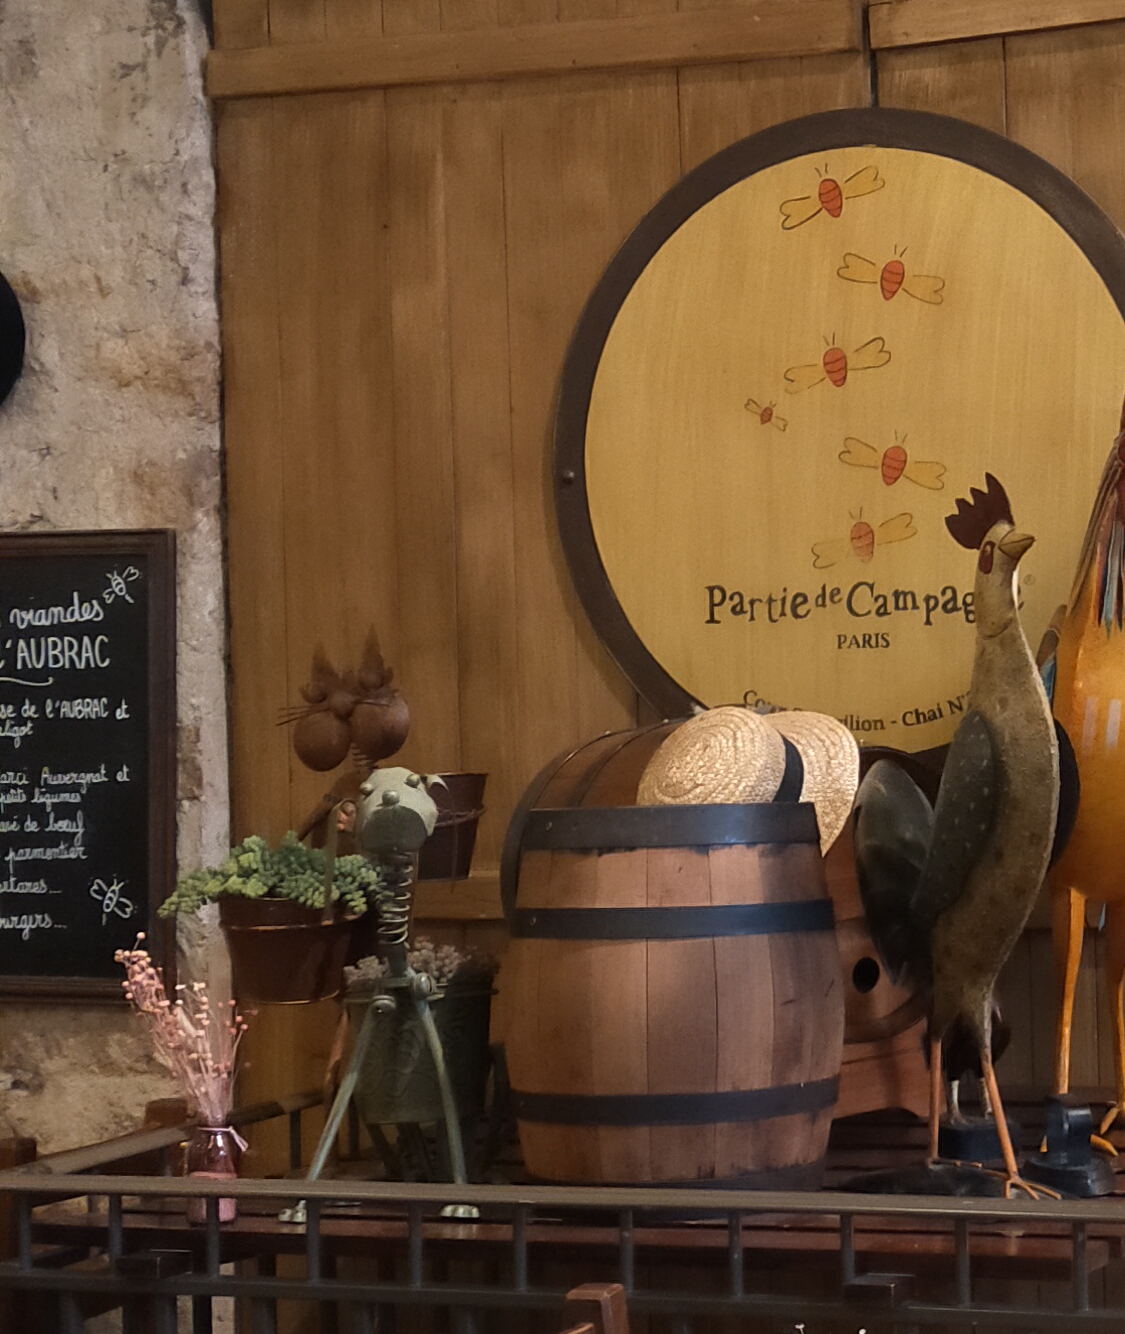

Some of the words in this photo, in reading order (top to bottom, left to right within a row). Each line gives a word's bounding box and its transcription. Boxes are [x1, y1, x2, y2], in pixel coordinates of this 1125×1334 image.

[9, 592, 104, 630] viandes
[704, 584, 812, 624] Partie
[815, 584, 844, 609] de
[846, 581, 1024, 626] Campag
[0, 635, 110, 670] 'AUBRAC
[836, 633, 890, 650] PARIS
[21, 698, 40, 718] de
[115, 698, 130, 720] et
[901, 703, 944, 727] Chai
[115, 764, 131, 783] et
[23, 814, 41, 833] de
